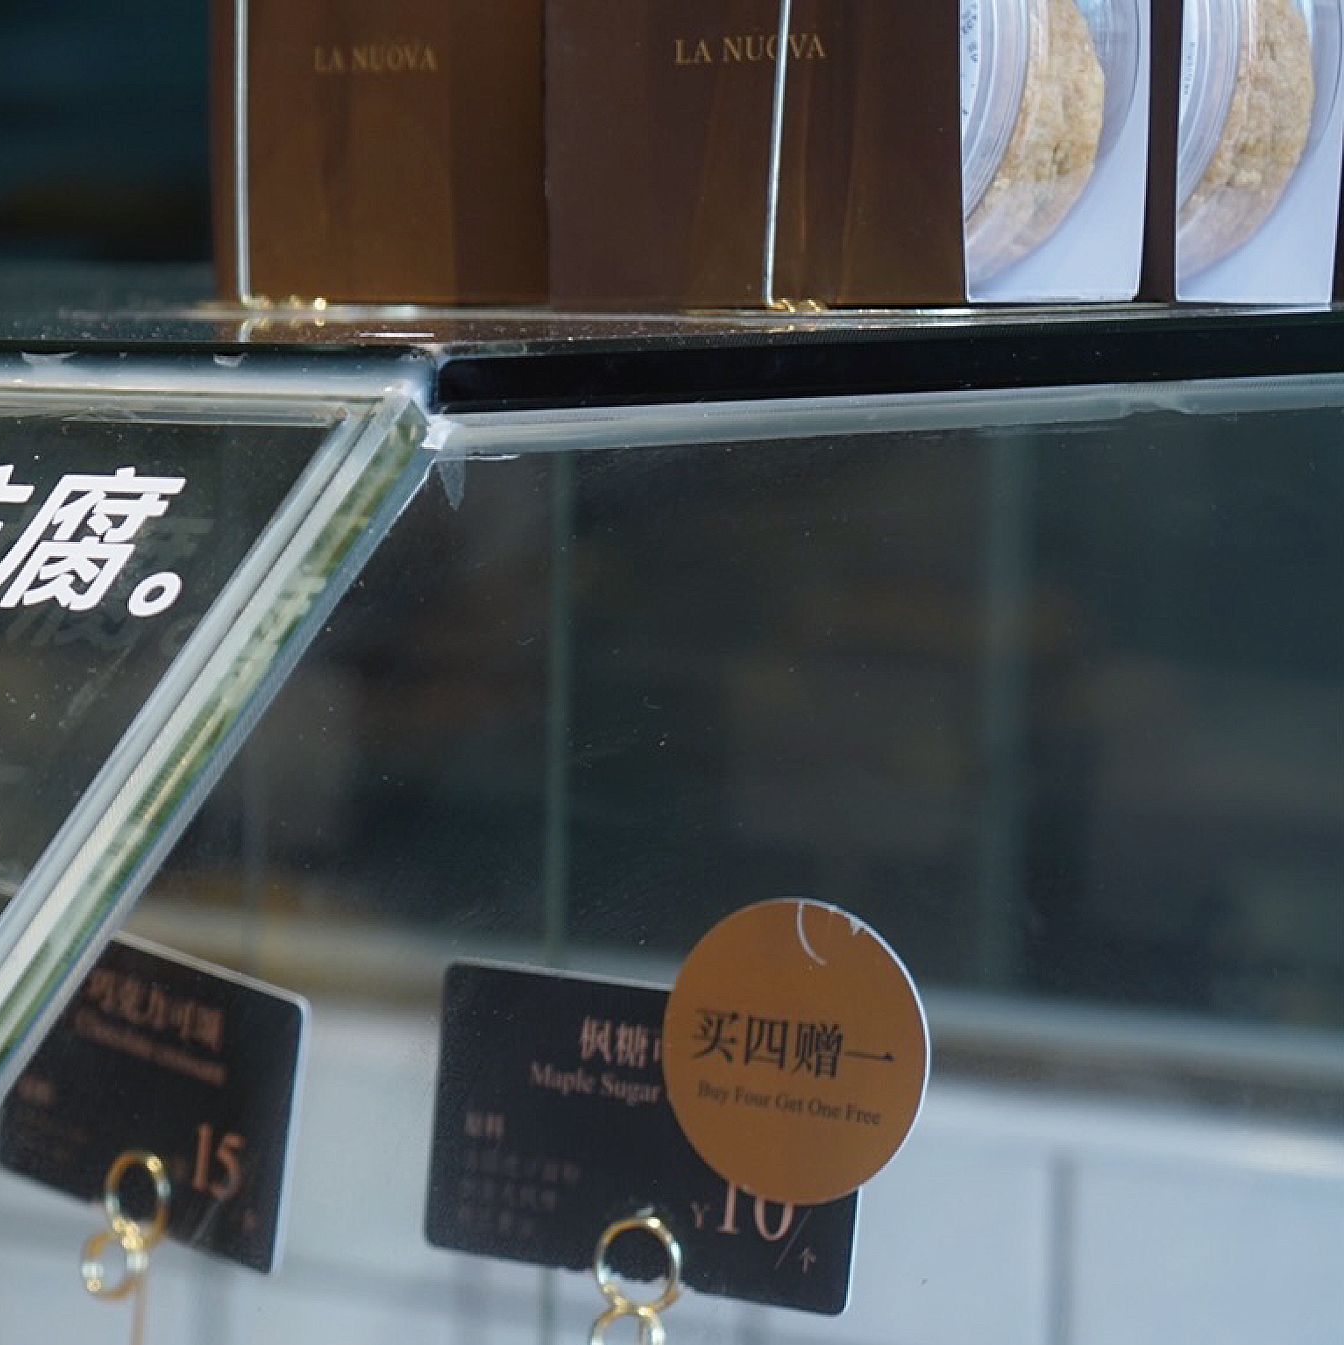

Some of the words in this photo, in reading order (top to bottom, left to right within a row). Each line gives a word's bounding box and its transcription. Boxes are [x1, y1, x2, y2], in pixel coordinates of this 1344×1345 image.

[313, 45, 345, 73] LA
[352, 44, 440, 73] NUOVA
[673, 37, 712, 65] LA
[579, 1016, 665, 1069] 枫糖
[692, 1009, 895, 1079] 买四赠一
[529, 1061, 595, 1095] Maple
[600, 1073, 662, 1106] Sugar
[698, 1079, 729, 1104] Buy
[734, 1085, 771, 1109] Four
[775, 1092, 804, 1113] Get
[808, 1099, 842, 1121] One
[844, 1103, 882, 1126] Free
[192, 1121, 246, 1201] 15
